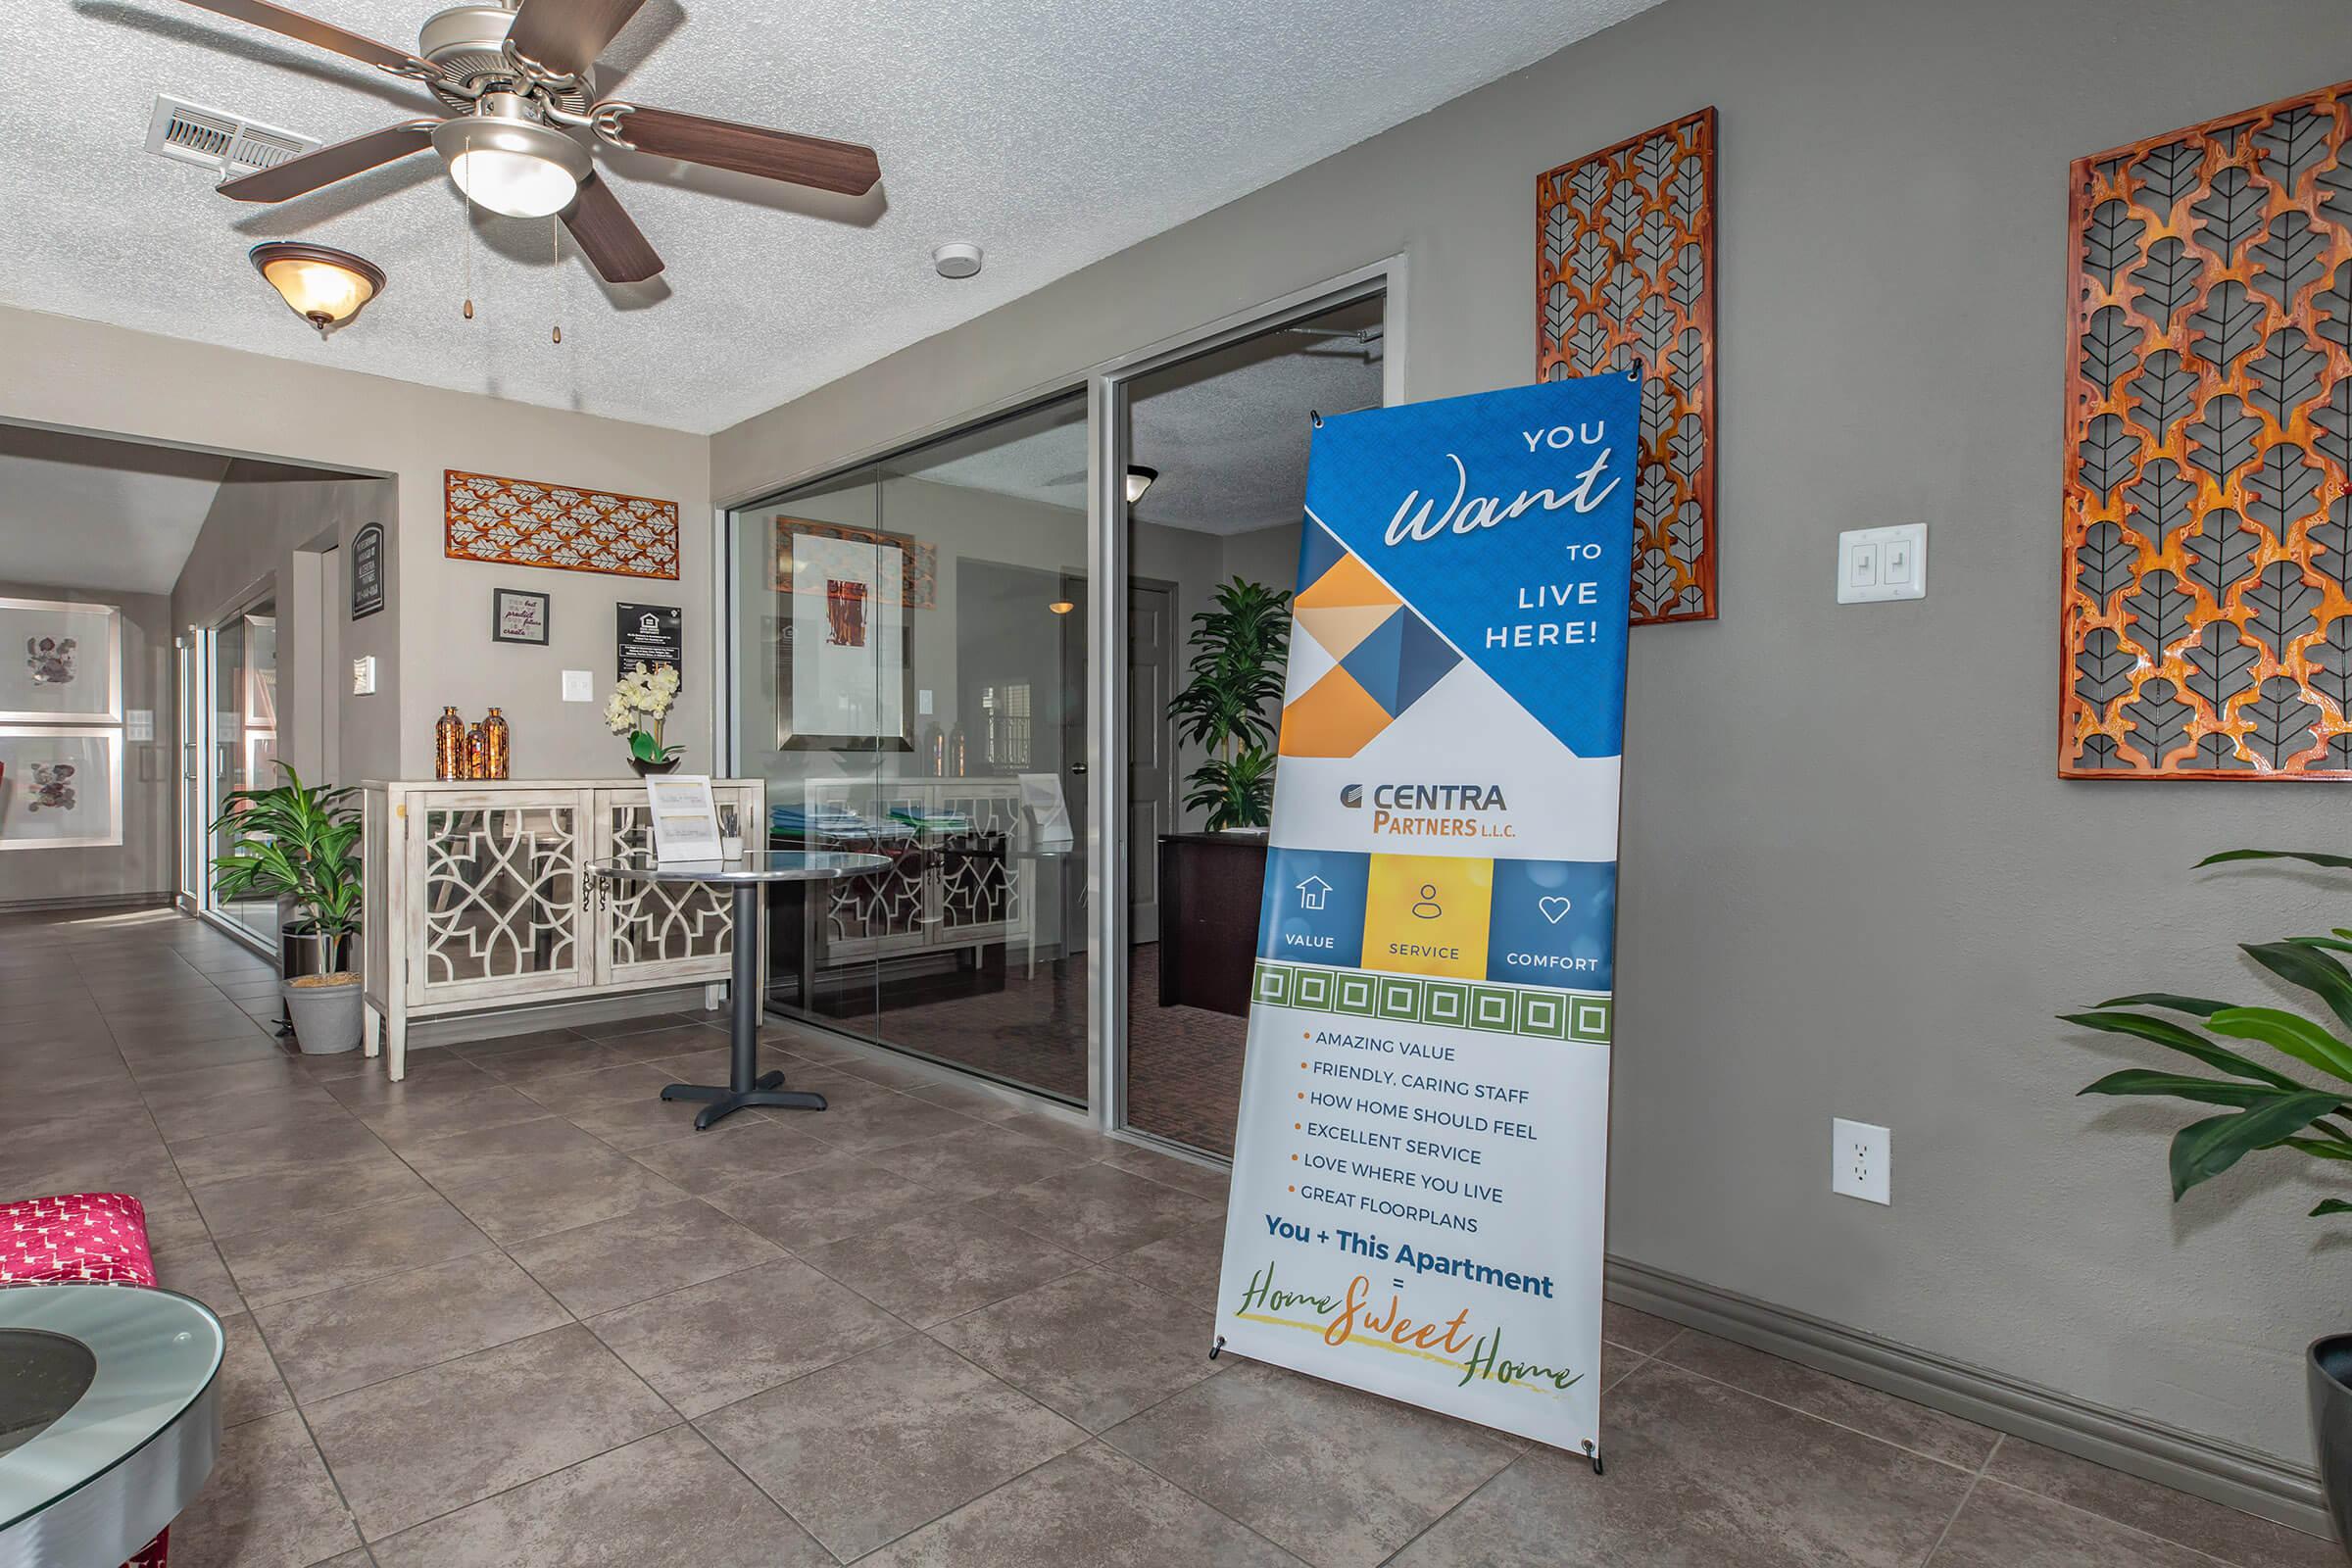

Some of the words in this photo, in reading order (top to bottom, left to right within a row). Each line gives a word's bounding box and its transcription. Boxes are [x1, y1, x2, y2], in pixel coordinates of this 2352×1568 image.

[1523, 420, 1605, 453] YOU
[1384, 448, 1620, 547] Want
[1567, 544, 1601, 562] TO
[1519, 581, 1597, 609] LIVE
[1486, 621, 1597, 649] HERE!
[1374, 784, 1506, 810] CENTRA
[1373, 809, 1477, 837] PARTNERS
[1481, 825, 1516, 837] L.L.C.
[1286, 933, 1334, 949] VALUE
[1390, 943, 1459, 959] SERVICE
[1506, 953, 1598, 972] COMFORT
[1316, 1031, 1395, 1054] AMAZING
[1399, 1043, 1455, 1061] VALUE
[1401, 1074, 1469, 1097] CARING
[1475, 1084, 1530, 1104] STAFF
[1310, 1091, 1352, 1110] HOW
[1356, 1099, 1409, 1120] HOME
[1414, 1107, 1488, 1132] SHOULD
[1494, 1120, 1537, 1140] FEEL
[1307, 1122, 1402, 1151] EXCELLENT
[1406, 1139, 1482, 1165] SERVICE
[1304, 1153, 1347, 1174] LOVE
[1351, 1162, 1415, 1188] WHERE
[1421, 1175, 1459, 1195] YOU
[1464, 1184, 1503, 1203] LIVE
[1300, 1185, 1356, 1207] GREAT
[1361, 1197, 1479, 1233] FLOORPLANS
[1265, 1214, 1309, 1244] You
[1317, 1230, 1330, 1244] +
[1337, 1230, 1389, 1260] This
[1395, 1245, 1554, 1298] Apartment
[1393, 1278, 1404, 1289] =
[1237, 1260, 1343, 1315] Home
[1324, 1275, 1474, 1353] Sweet
[1458, 1327, 1584, 1389] Home
